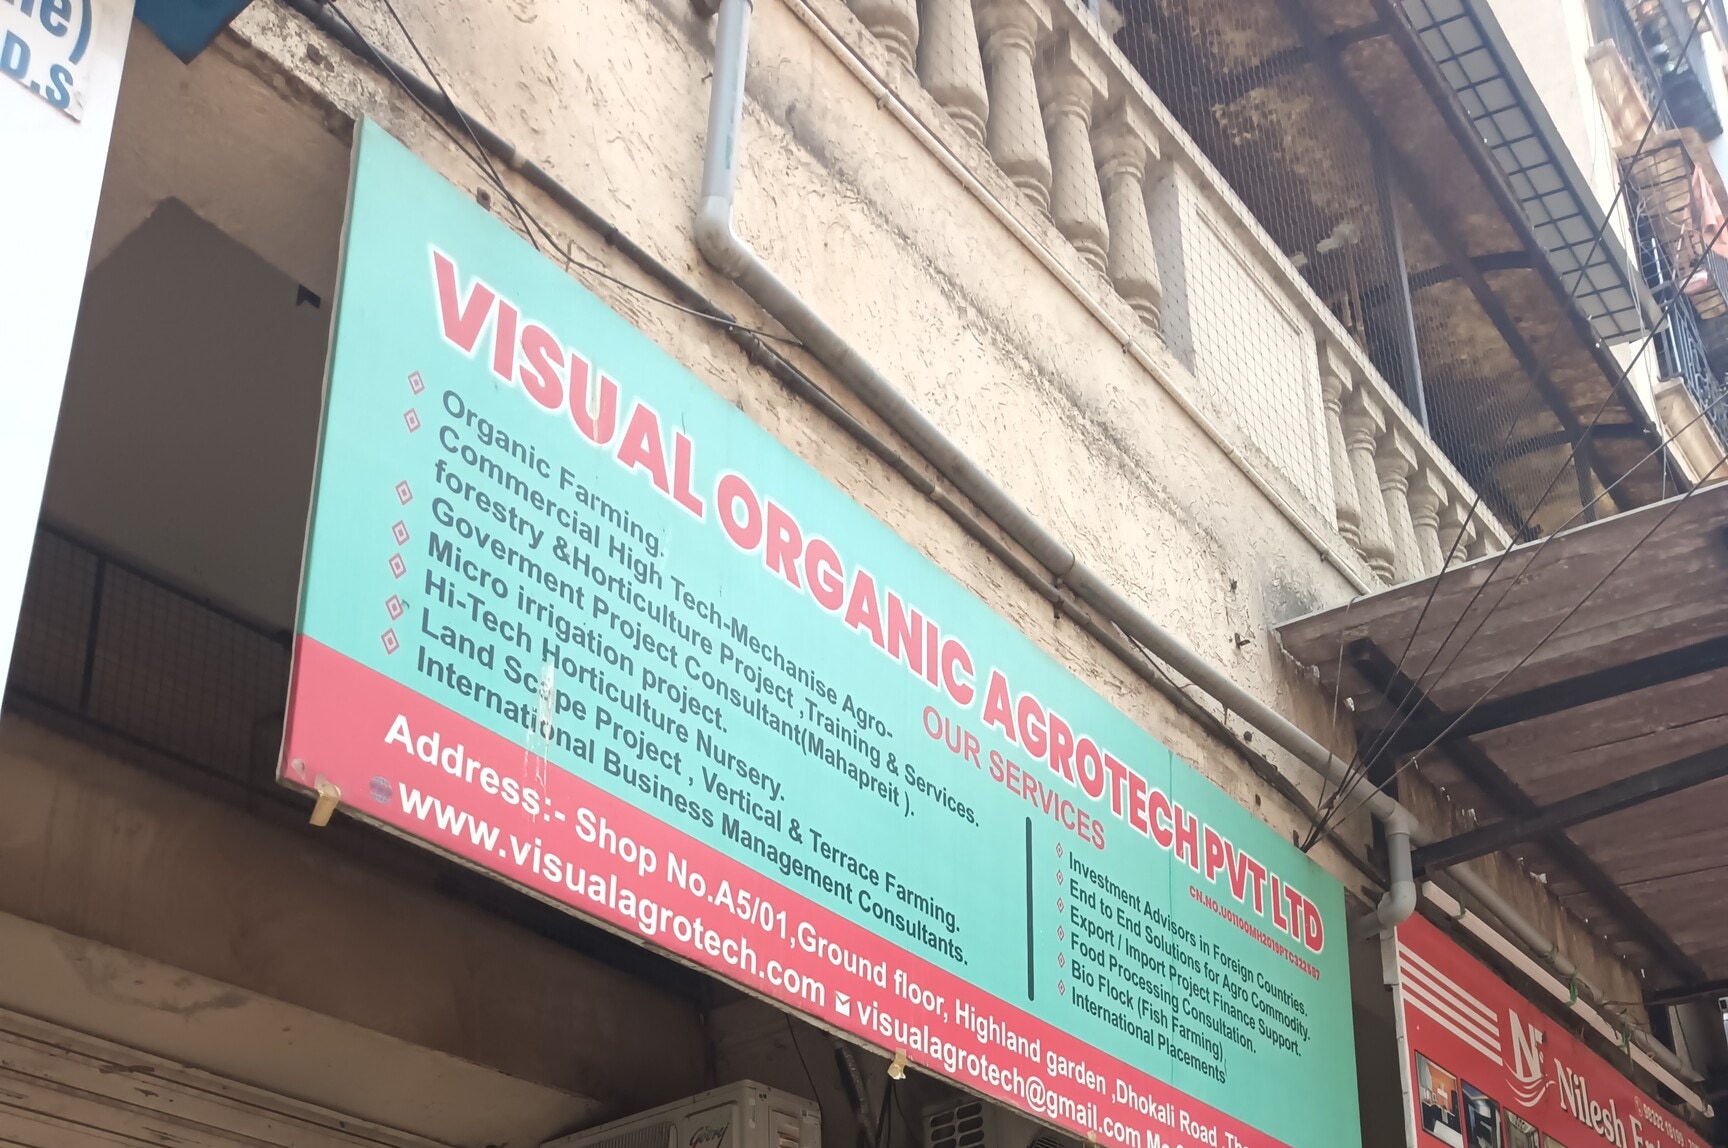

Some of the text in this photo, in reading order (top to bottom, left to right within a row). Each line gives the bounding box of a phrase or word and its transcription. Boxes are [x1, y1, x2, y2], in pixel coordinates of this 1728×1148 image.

[442, 389, 665, 558] Organic Farming.
[428, 530, 728, 734] Micro irrigation project.
[431, 496, 585, 611] Goverment
[592, 594, 678, 669] Project
[434, 458, 545, 550] forestry
[719, 641, 794, 710] Project
[886, 751, 900, 777] &
[904, 763, 979, 828] Services.
[436, 255, 1323, 952] VISUAL ORGANIC AGROTECH PVT LTD
[439, 425, 893, 739] Commercial High Tech-Mechanise Agro-
[421, 606, 495, 671] Land
[595, 705, 682, 777] Project
[701, 765, 782, 833] Vertical
[788, 817, 804, 845] &
[808, 827, 880, 887] Terrace
[885, 871, 960, 934] Farming.
[424, 568, 785, 802] Hi-Tech Horticulture Nursery.
[921, 705, 1107, 852] OUR SERVICES
[398, 782, 825, 1007] www.visualagrotech.com
[417, 645, 968, 966] International Business Management Consultants.
[384, 714, 566, 823] Address:-
[575, 807, 657, 877] Shop
[893, 968, 948, 1024] floor,
[955, 998, 1041, 1064] Highland
[1046, 1050, 1106, 1096] garden
[1179, 1109, 1218, 1148] Road
[1069, 850, 1308, 1017] Investment Advisors in Foreign Countries.
[1069, 877, 1311, 1043] End to End Solutions for Agro Commodity.
[1070, 904, 1302, 1057] Export Import Project Finance Support.
[1070, 931, 1257, 1054] Food Processing Consultation.
[1071, 958, 1224, 1063] Bio Flock (Fish Farming)
[1071, 985, 1226, 1085] International Placements
